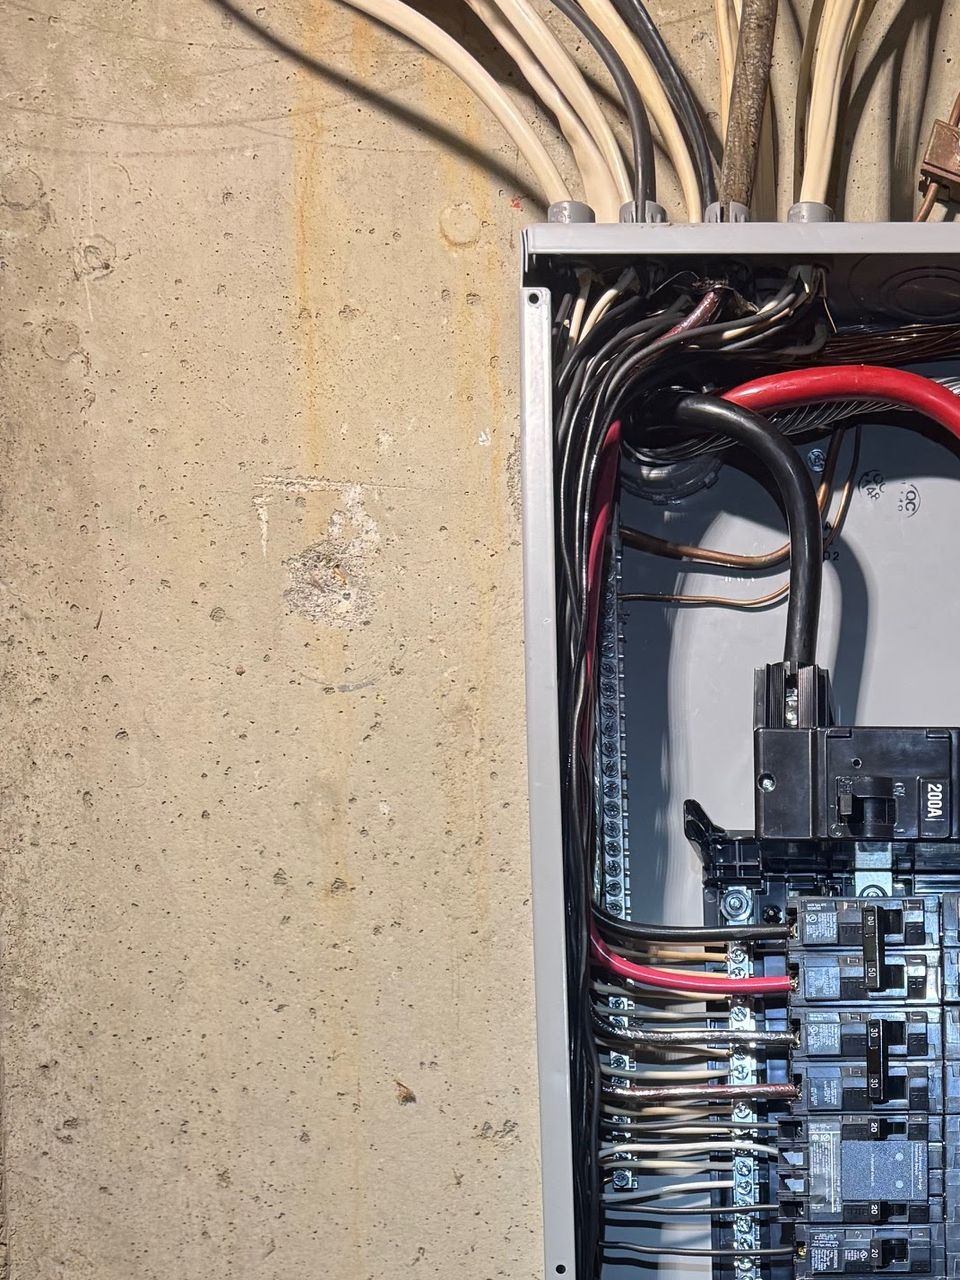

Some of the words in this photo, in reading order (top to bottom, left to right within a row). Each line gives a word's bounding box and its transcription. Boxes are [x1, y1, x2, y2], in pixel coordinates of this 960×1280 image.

[905, 490, 916, 511] QC
[928, 783, 942, 817] 200A
[868, 967, 875, 978] 50
[870, 1028, 878, 1038] 30
[870, 1077, 878, 1088] 30
[870, 1122, 878, 1132] 20
[870, 1204, 878, 1215] 20
[872, 1250, 878, 1258] 20
